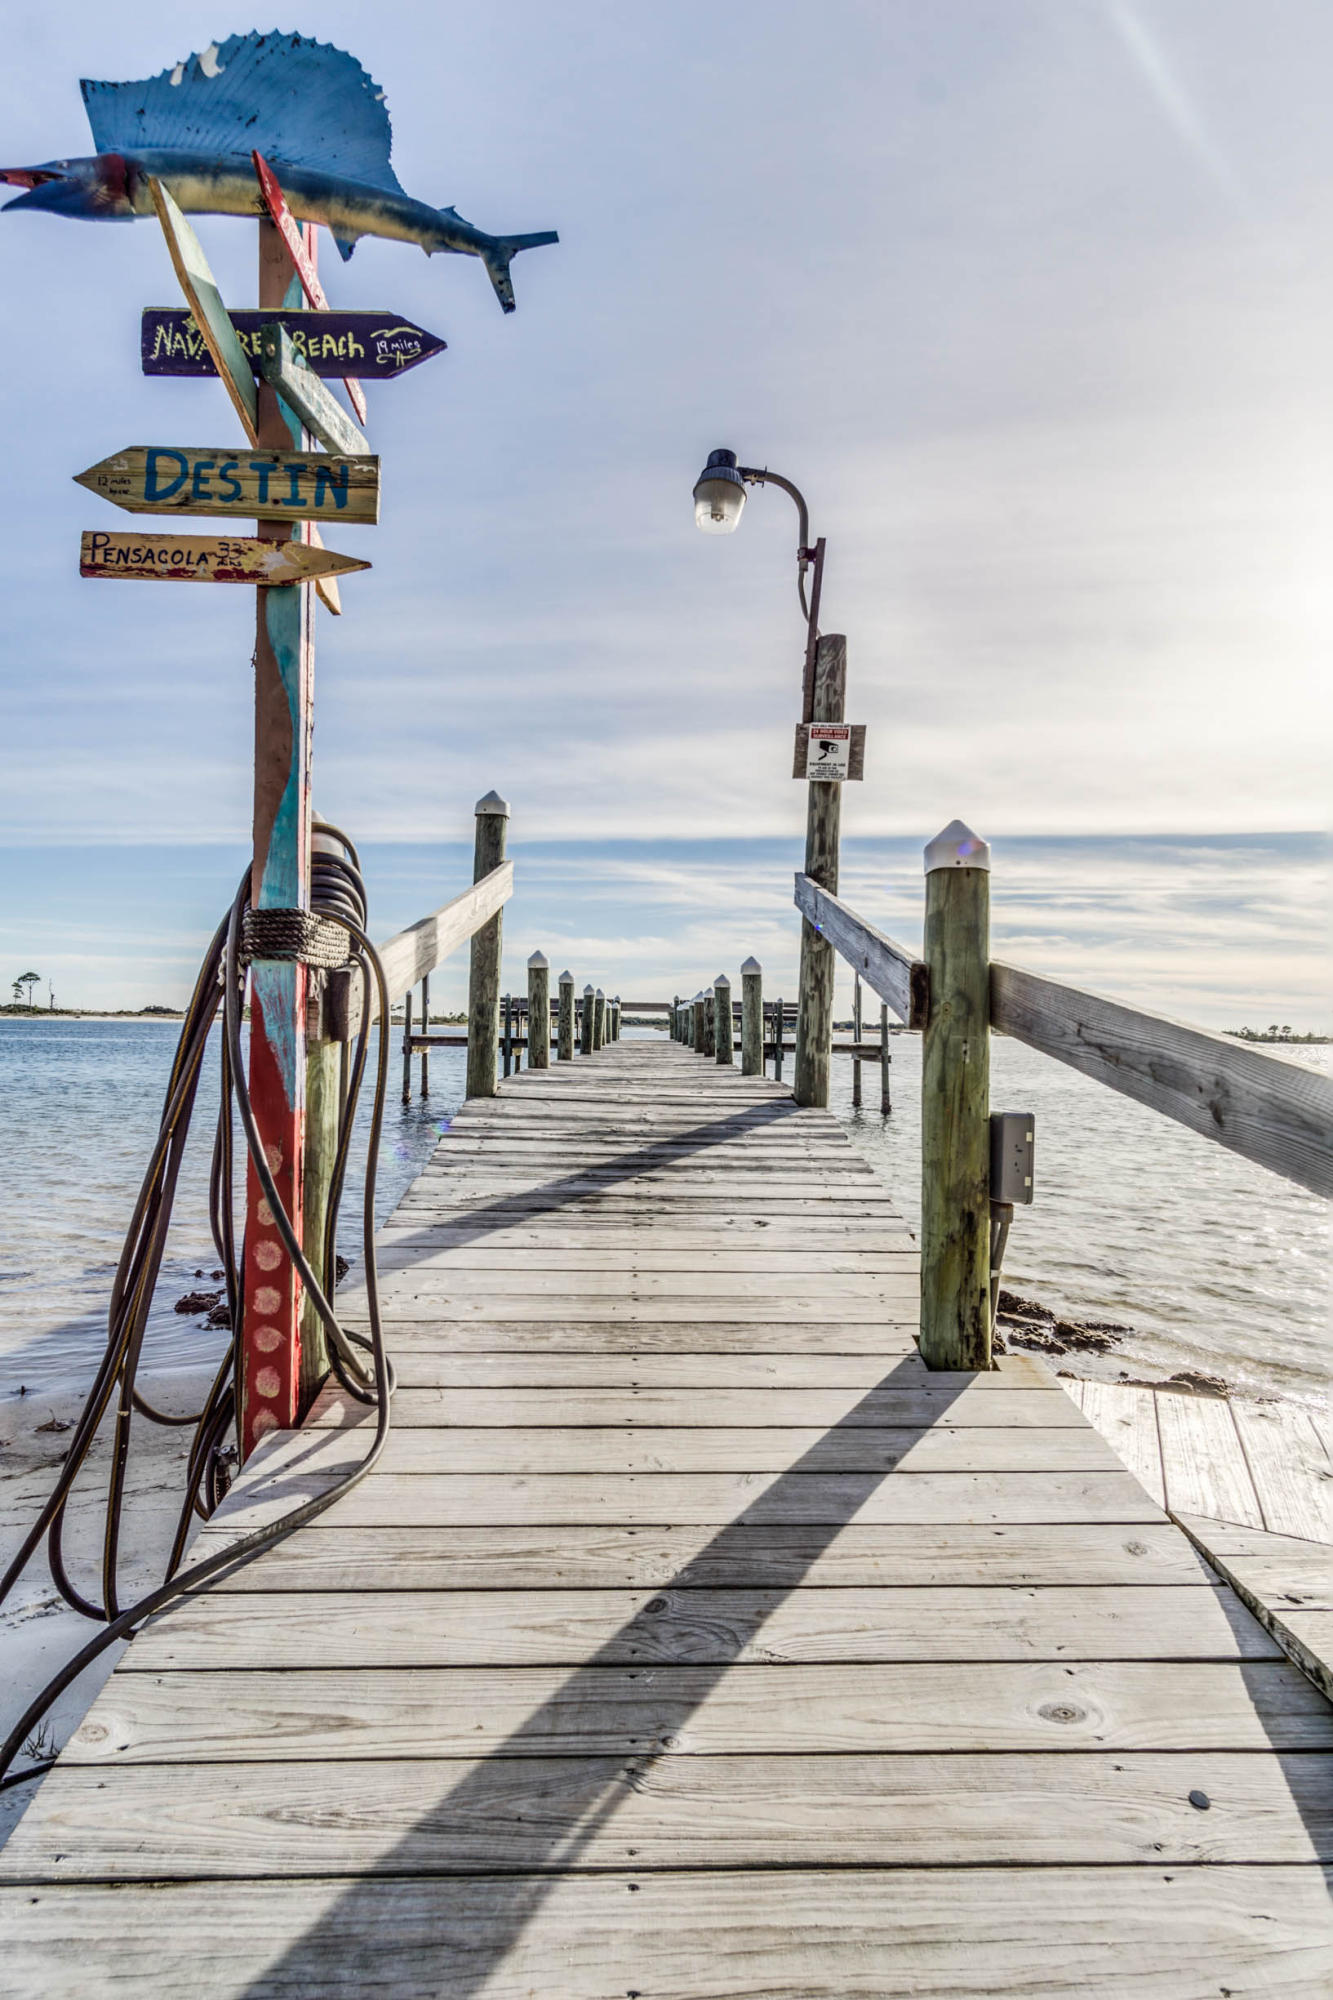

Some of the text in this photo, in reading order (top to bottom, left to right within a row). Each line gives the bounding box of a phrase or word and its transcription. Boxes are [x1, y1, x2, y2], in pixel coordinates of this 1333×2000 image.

[150, 322, 262, 360] NAVARE
[376, 340, 389, 355] 19
[97, 476, 109, 486] 12
[145, 448, 348, 509] DESTIN
[90, 532, 241, 566] PENSACOLA 33
